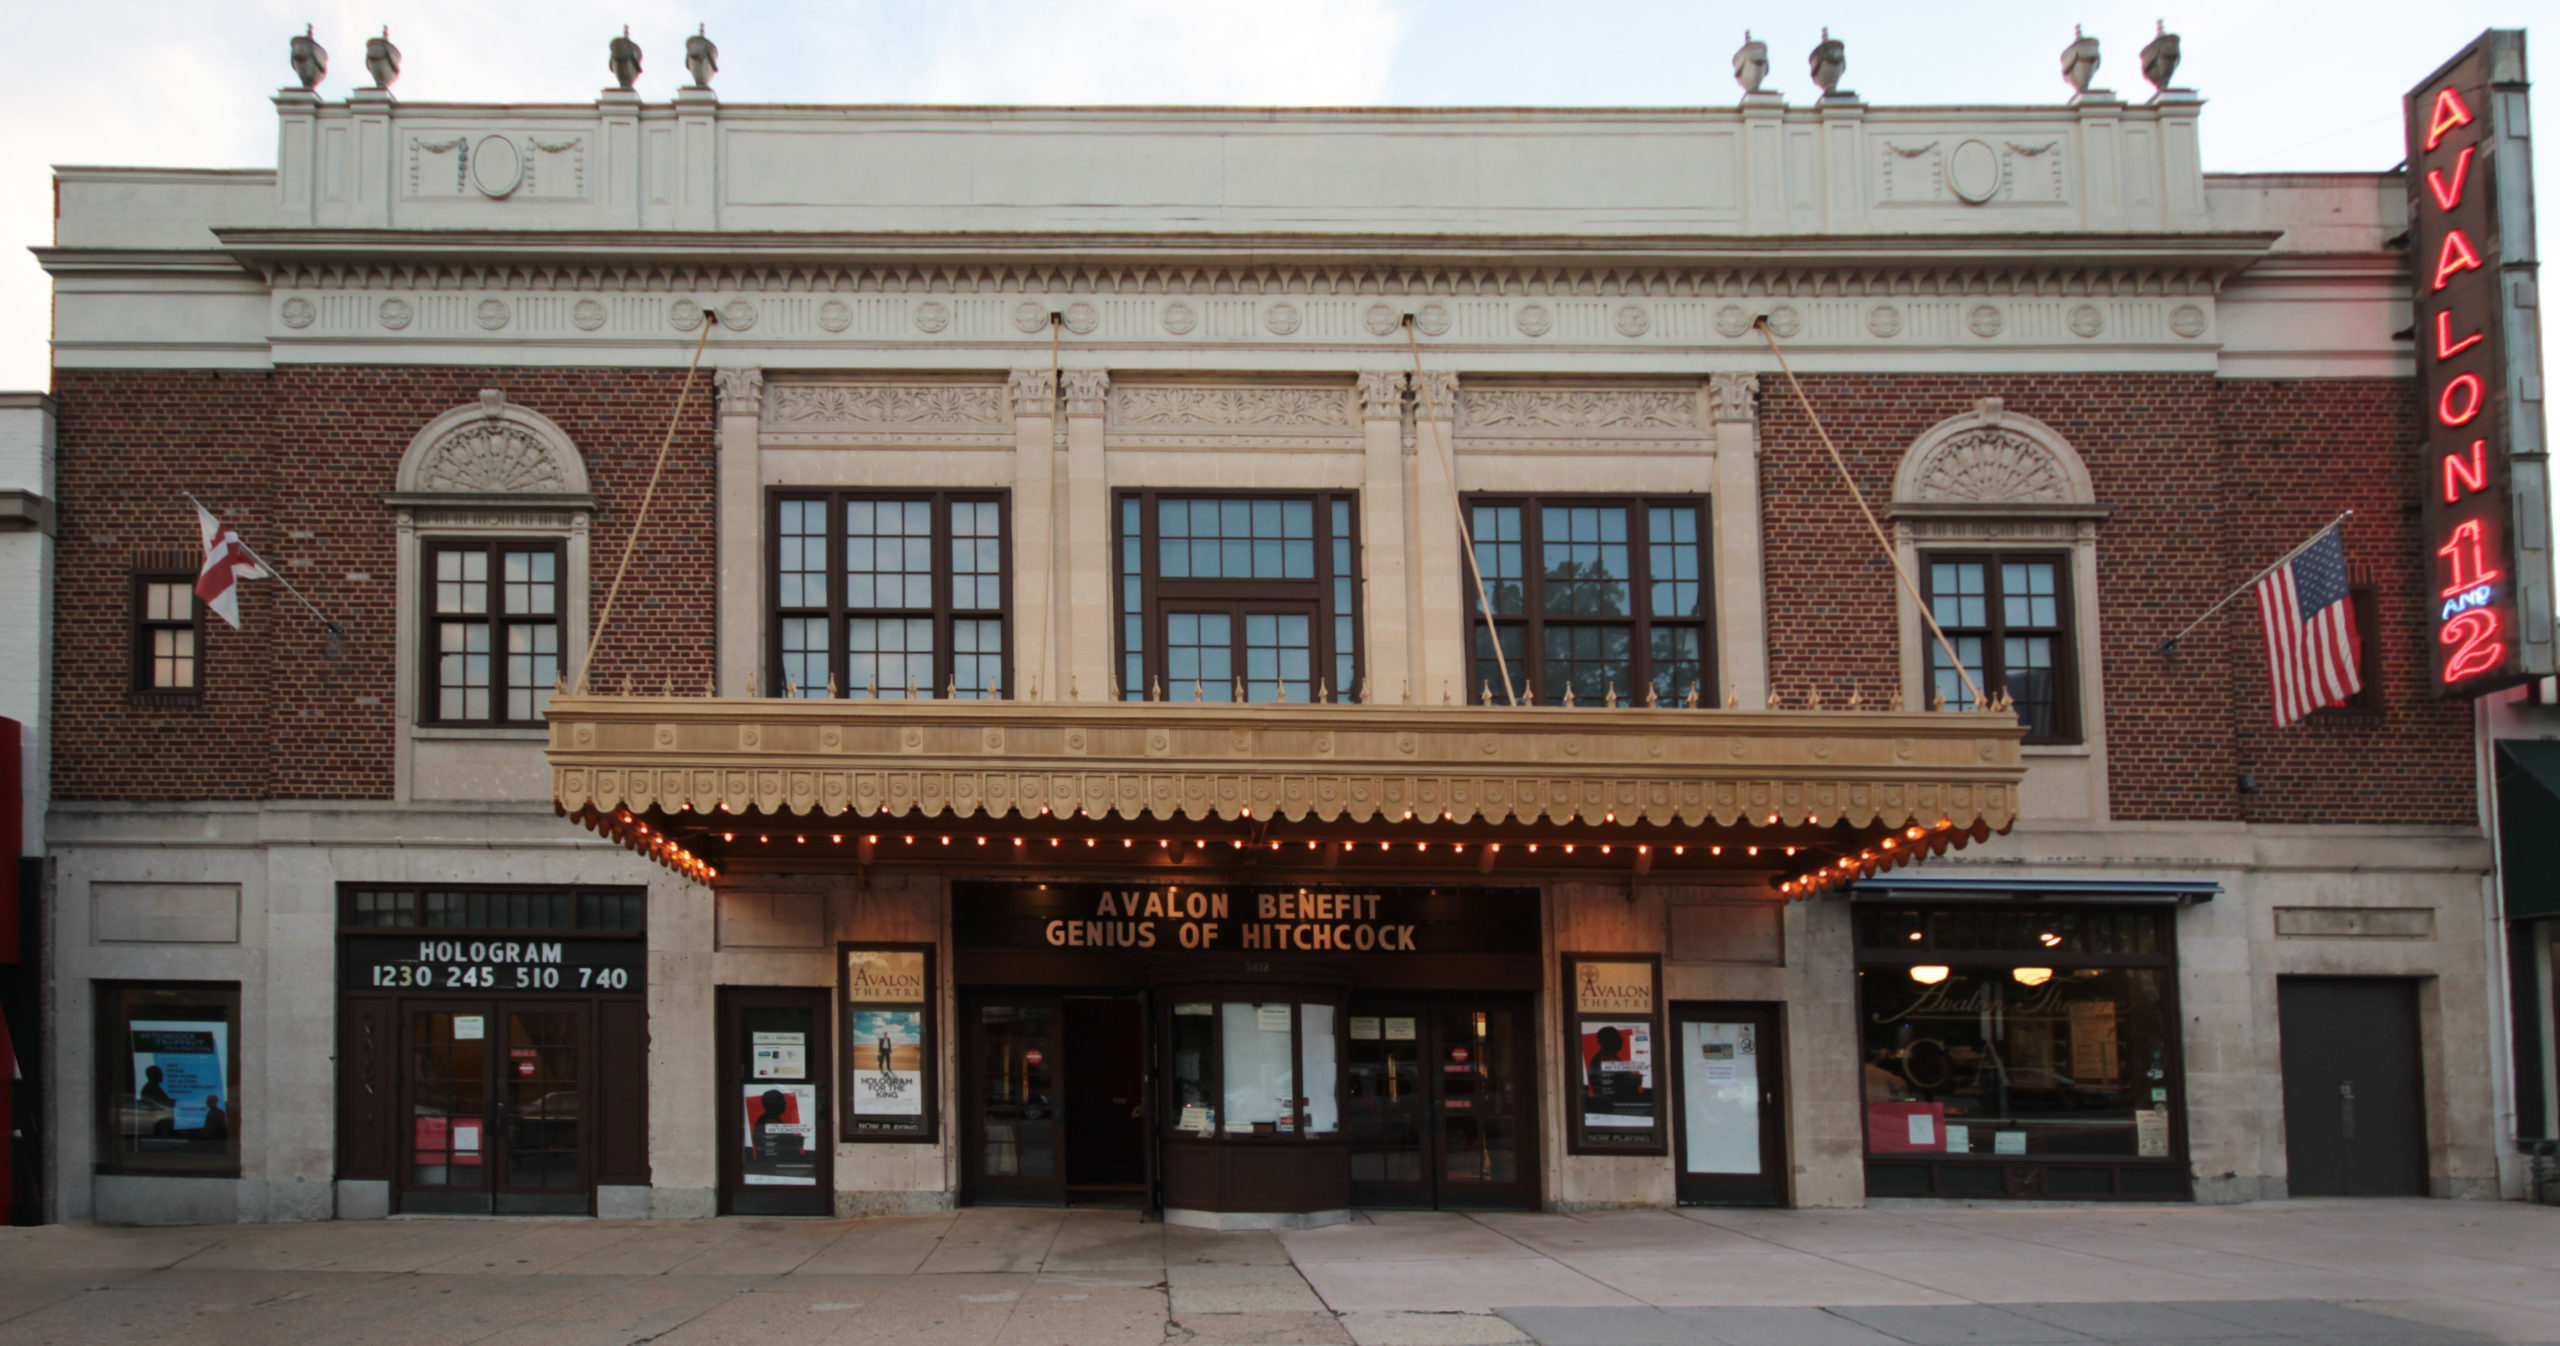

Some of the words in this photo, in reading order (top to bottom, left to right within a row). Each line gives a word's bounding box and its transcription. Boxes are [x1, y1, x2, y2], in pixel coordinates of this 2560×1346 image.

[2425, 85, 2488, 503] AVALON
[2437, 518, 2499, 598] 1
[2441, 585, 2492, 620] AND
[2440, 607, 2504, 683] 2
[1096, 890, 1229, 919] AVALON
[1258, 893, 1381, 920] BENEFIT
[1045, 919, 1157, 947] GENIUS
[1178, 922, 1219, 949] OF
[1242, 923, 1416, 951] HITCHCOCK
[419, 941, 562, 964] HOLOGRAM
[373, 965, 432, 987] 1230
[445, 966, 495, 988] 245
[516, 967, 560, 989] 510
[578, 967, 628, 990] 740
[854, 968, 921, 987] AVALON
[1581, 978, 1650, 997] AVALON
[854, 987, 921, 997] THEATRE
[1581, 998, 1650, 1008] THEATRE
[860, 1077, 913, 1086] HOLOGRAM
